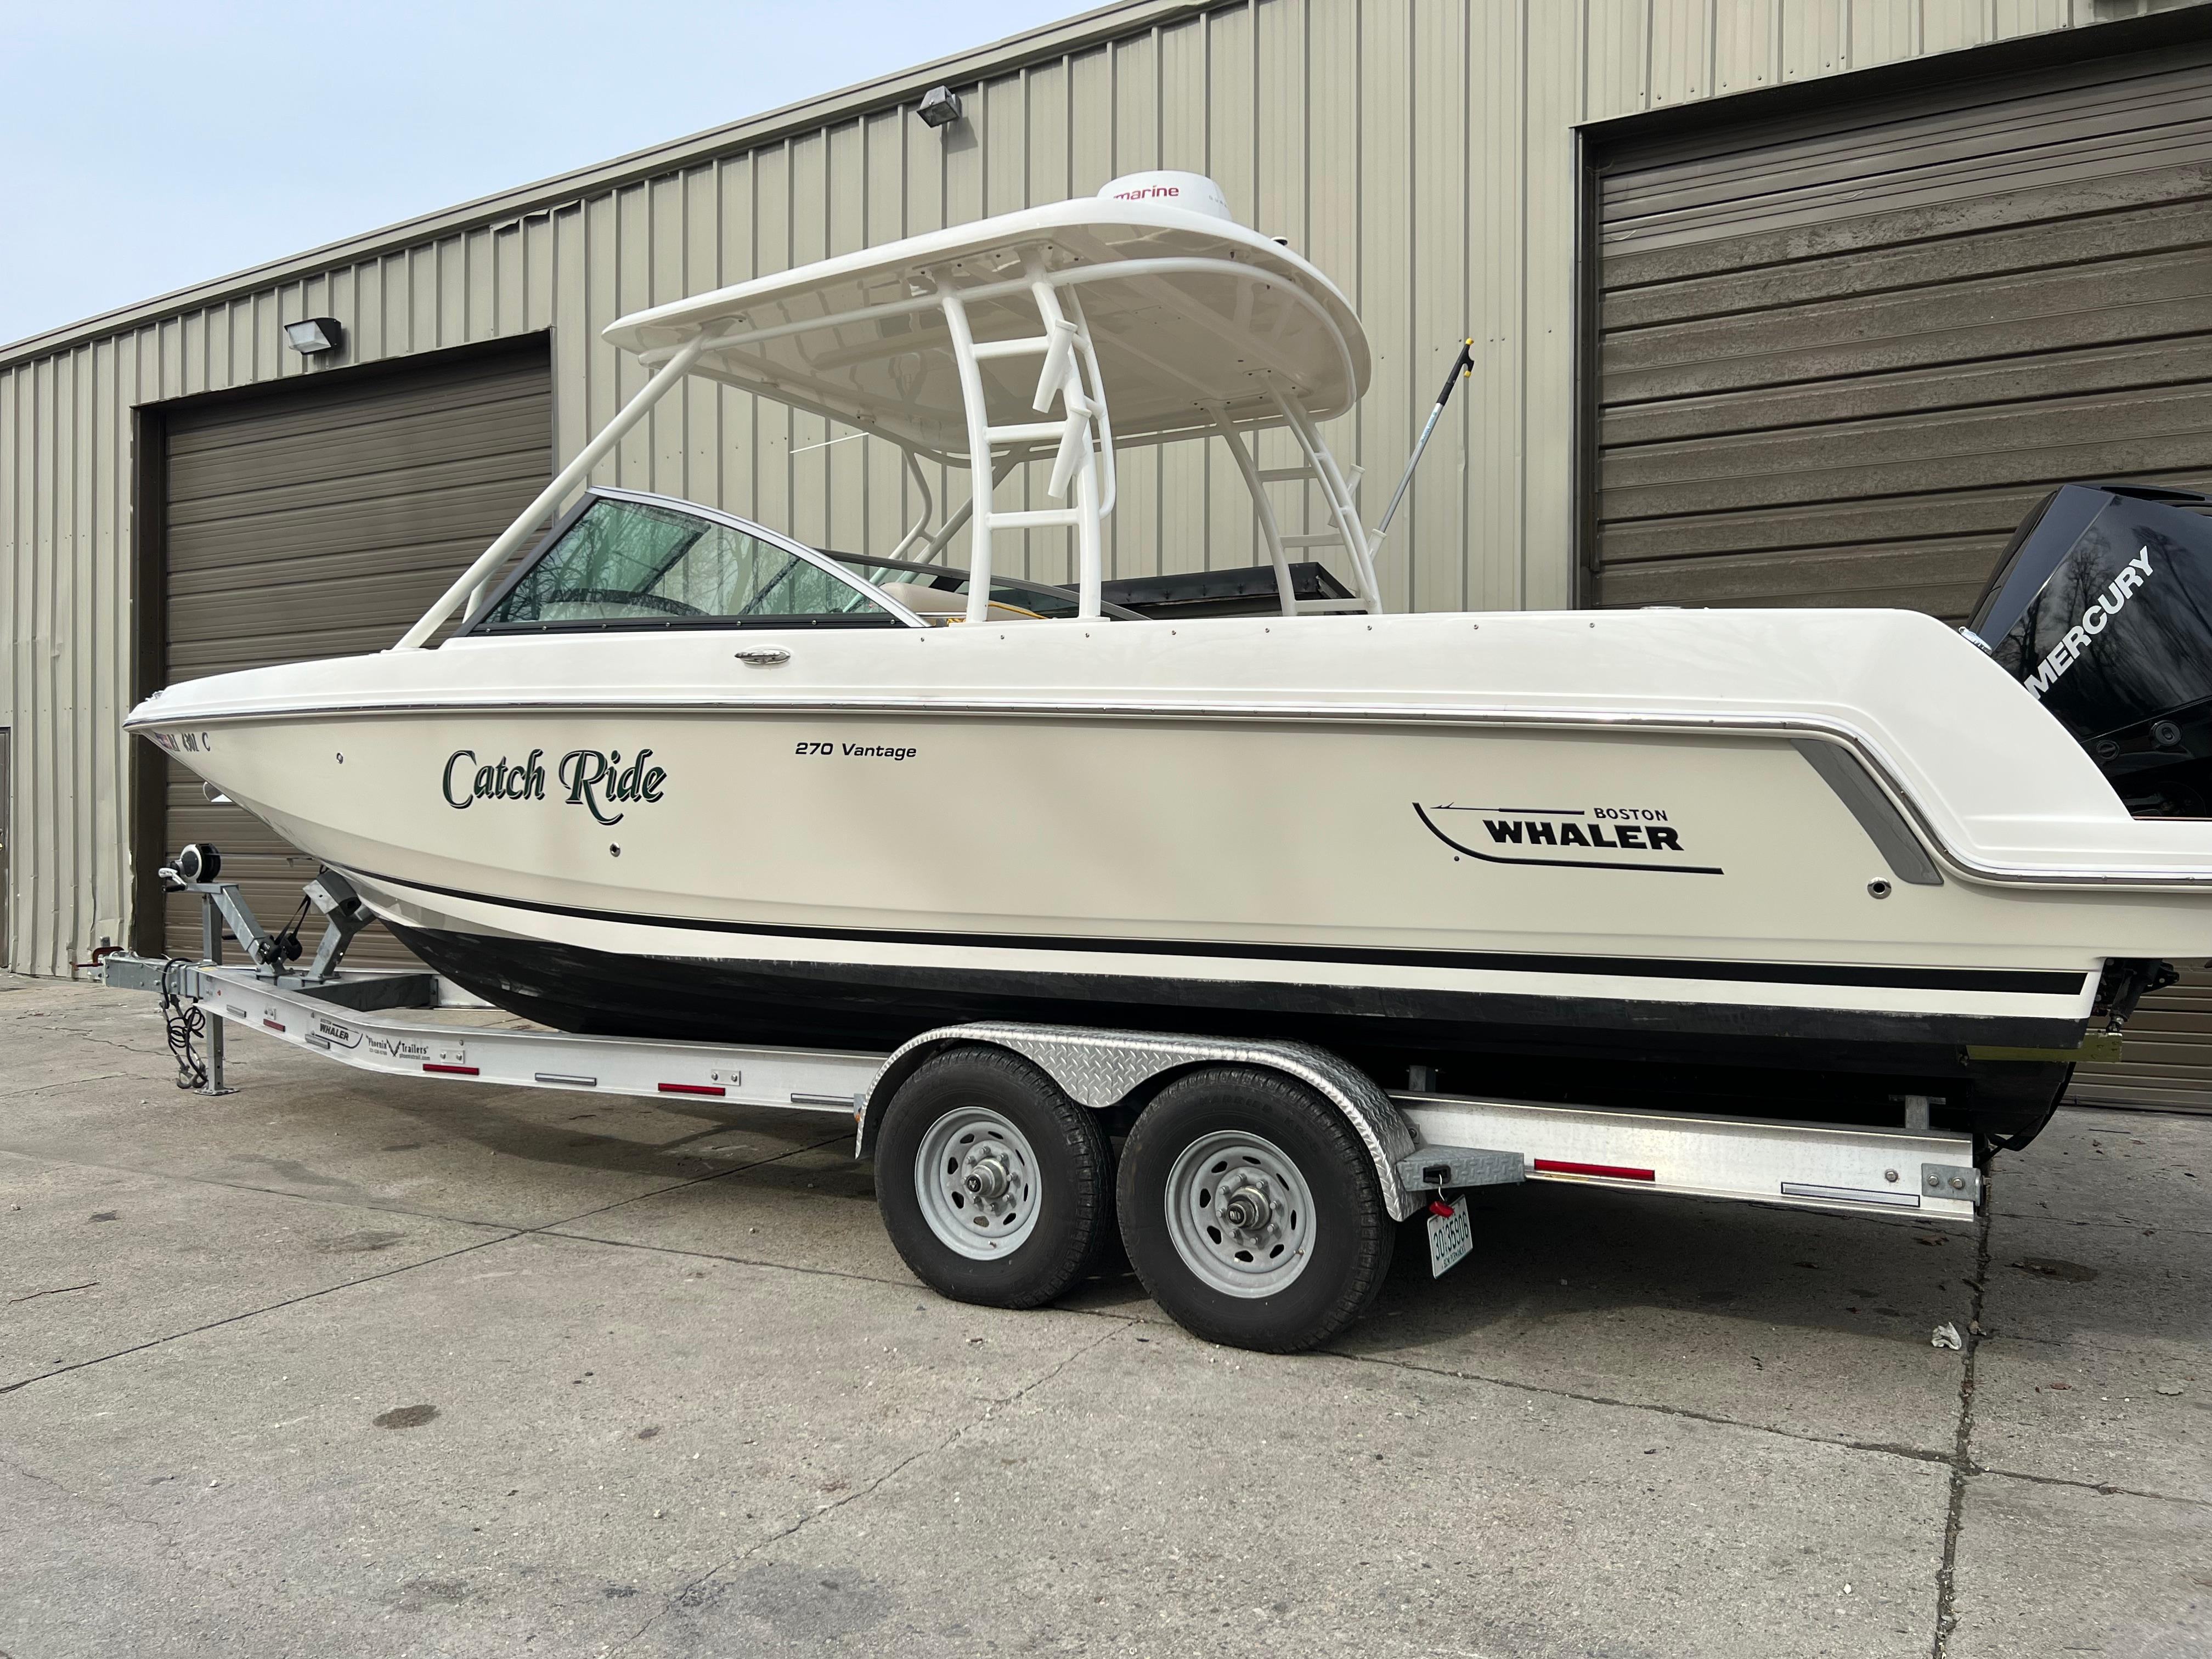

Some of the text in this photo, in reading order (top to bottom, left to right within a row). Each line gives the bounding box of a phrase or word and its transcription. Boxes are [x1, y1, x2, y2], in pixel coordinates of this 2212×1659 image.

[1114, 185, 1179, 201] marine
[2024, 545, 2153, 701] MERCURY
[201, 732, 211, 752] C
[795, 742, 917, 761] 270 Vantage
[443, 749, 668, 826] Catch Ride
[1594, 808, 1668, 821] BOSTON
[1482, 819, 1685, 851] WHALER
[320, 1023, 349, 1041] WHALER
